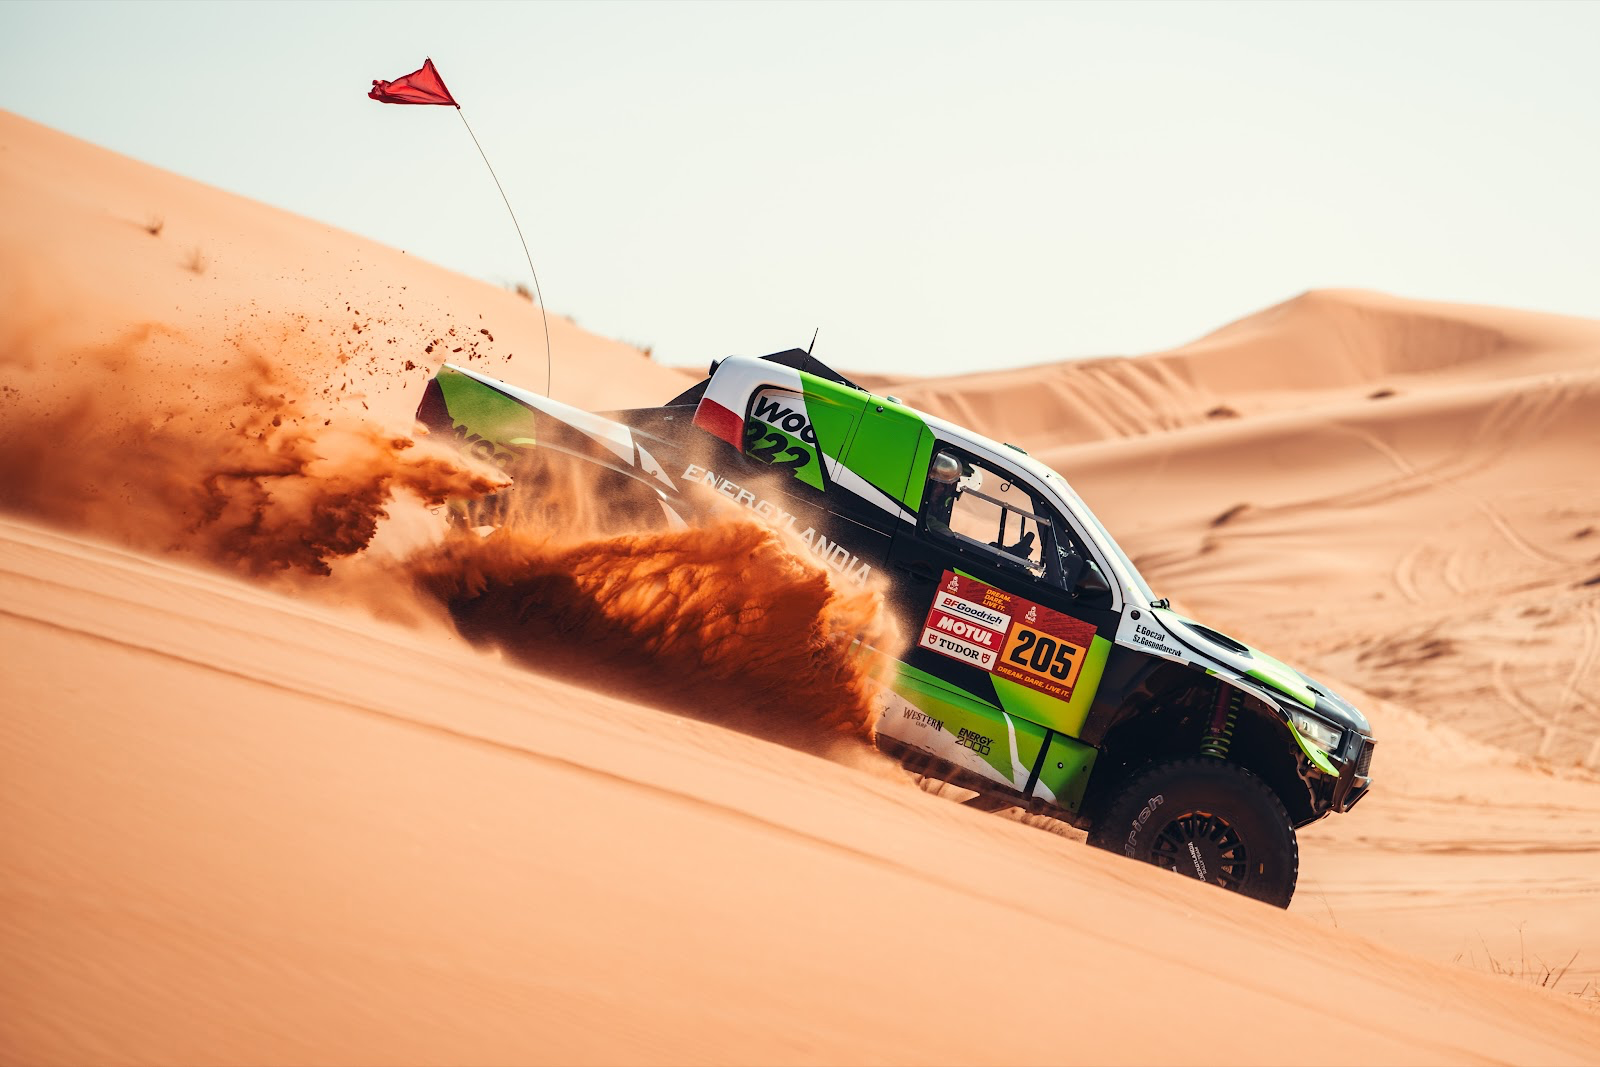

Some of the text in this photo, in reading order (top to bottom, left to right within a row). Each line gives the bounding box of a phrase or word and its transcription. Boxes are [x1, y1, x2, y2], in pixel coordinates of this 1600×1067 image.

[681, 463, 872, 590] ENERGYLANDIA
[982, 599, 997, 608] LIVE
[984, 595, 1003, 605] DARE.
[986, 589, 1011, 602] DREAM.
[942, 597, 1003, 625] BFGoodrich
[936, 616, 993, 646] MOTUL
[939, 638, 980, 660] TUDOR
[1009, 629, 1077, 681] 205
[997, 666, 1069, 697] DREAM. DARE. LIVE IT.
[903, 706, 945, 732] WESTERN
[955, 735, 991, 756] 2000
[958, 727, 993, 746] ENERGY
